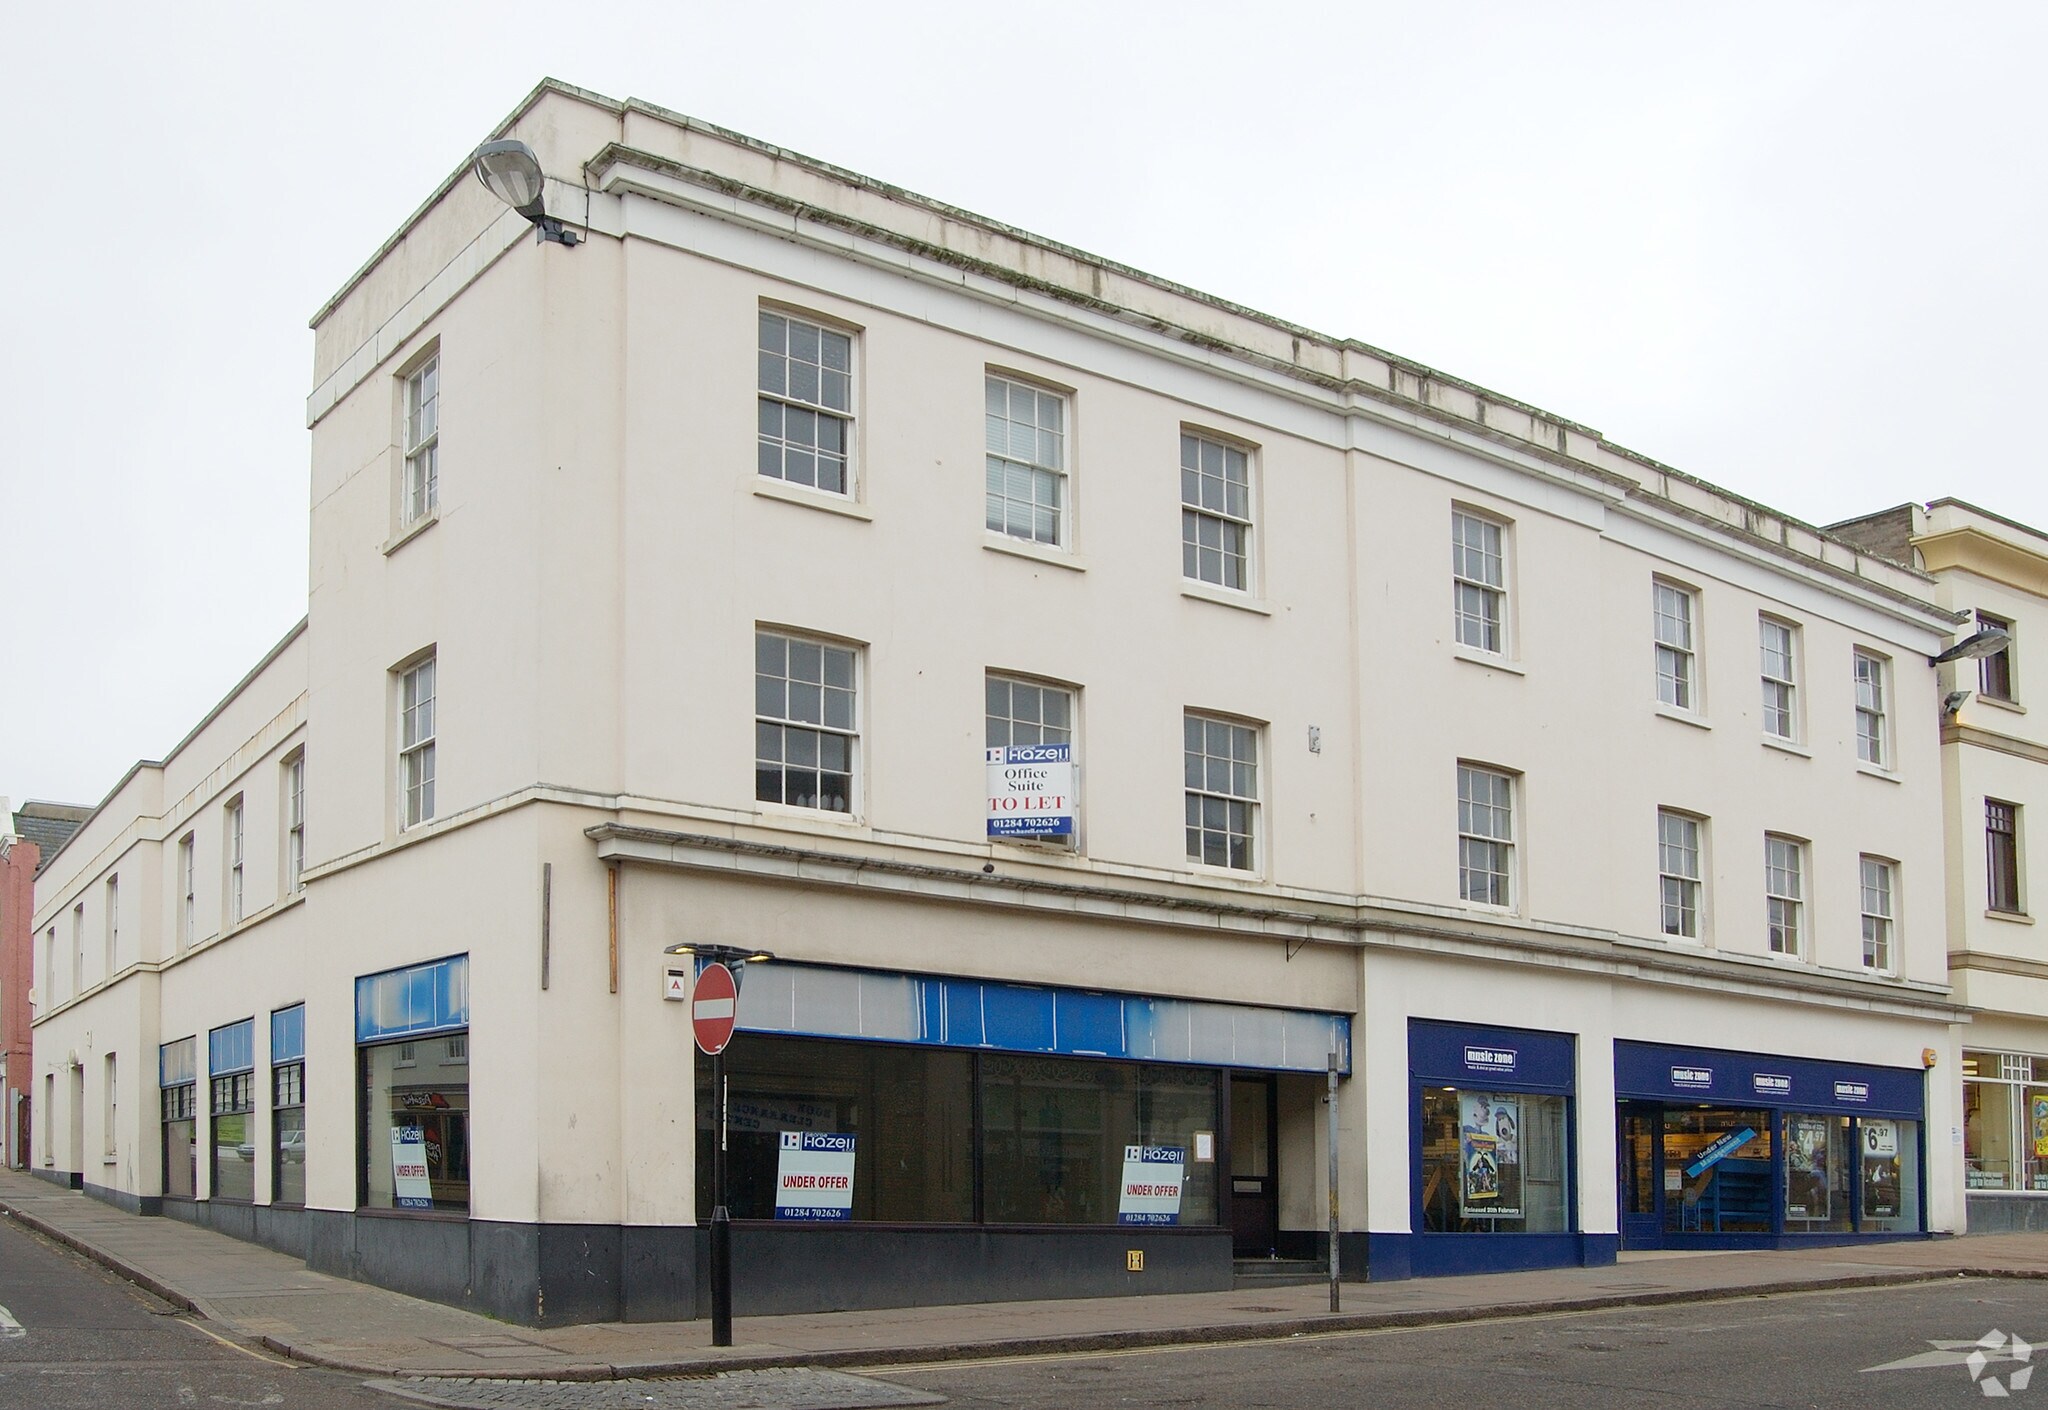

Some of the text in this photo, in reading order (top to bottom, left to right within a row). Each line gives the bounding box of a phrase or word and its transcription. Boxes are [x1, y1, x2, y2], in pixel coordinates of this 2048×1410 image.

[1009, 748, 1068, 761] Hazell
[1004, 768, 1048, 779] Office
[1008, 780, 1044, 792] Suite
[988, 796, 1066, 811] TO LET
[993, 818, 1060, 828] 01284 702626
[1468, 1051, 1513, 1064] music zone
[804, 1136, 855, 1148] Hazell
[1697, 1134, 1732, 1159] Under New
[1143, 1150, 1184, 1161] Hazell
[1700, 1138, 1741, 1168] Management
[783, 1175, 848, 1189] UNDER OFFER
[1127, 1184, 1178, 1197] UNDER OFFER
[784, 1208, 841, 1217] 01284 702626
[1126, 1214, 1170, 1222] 01284 702626
